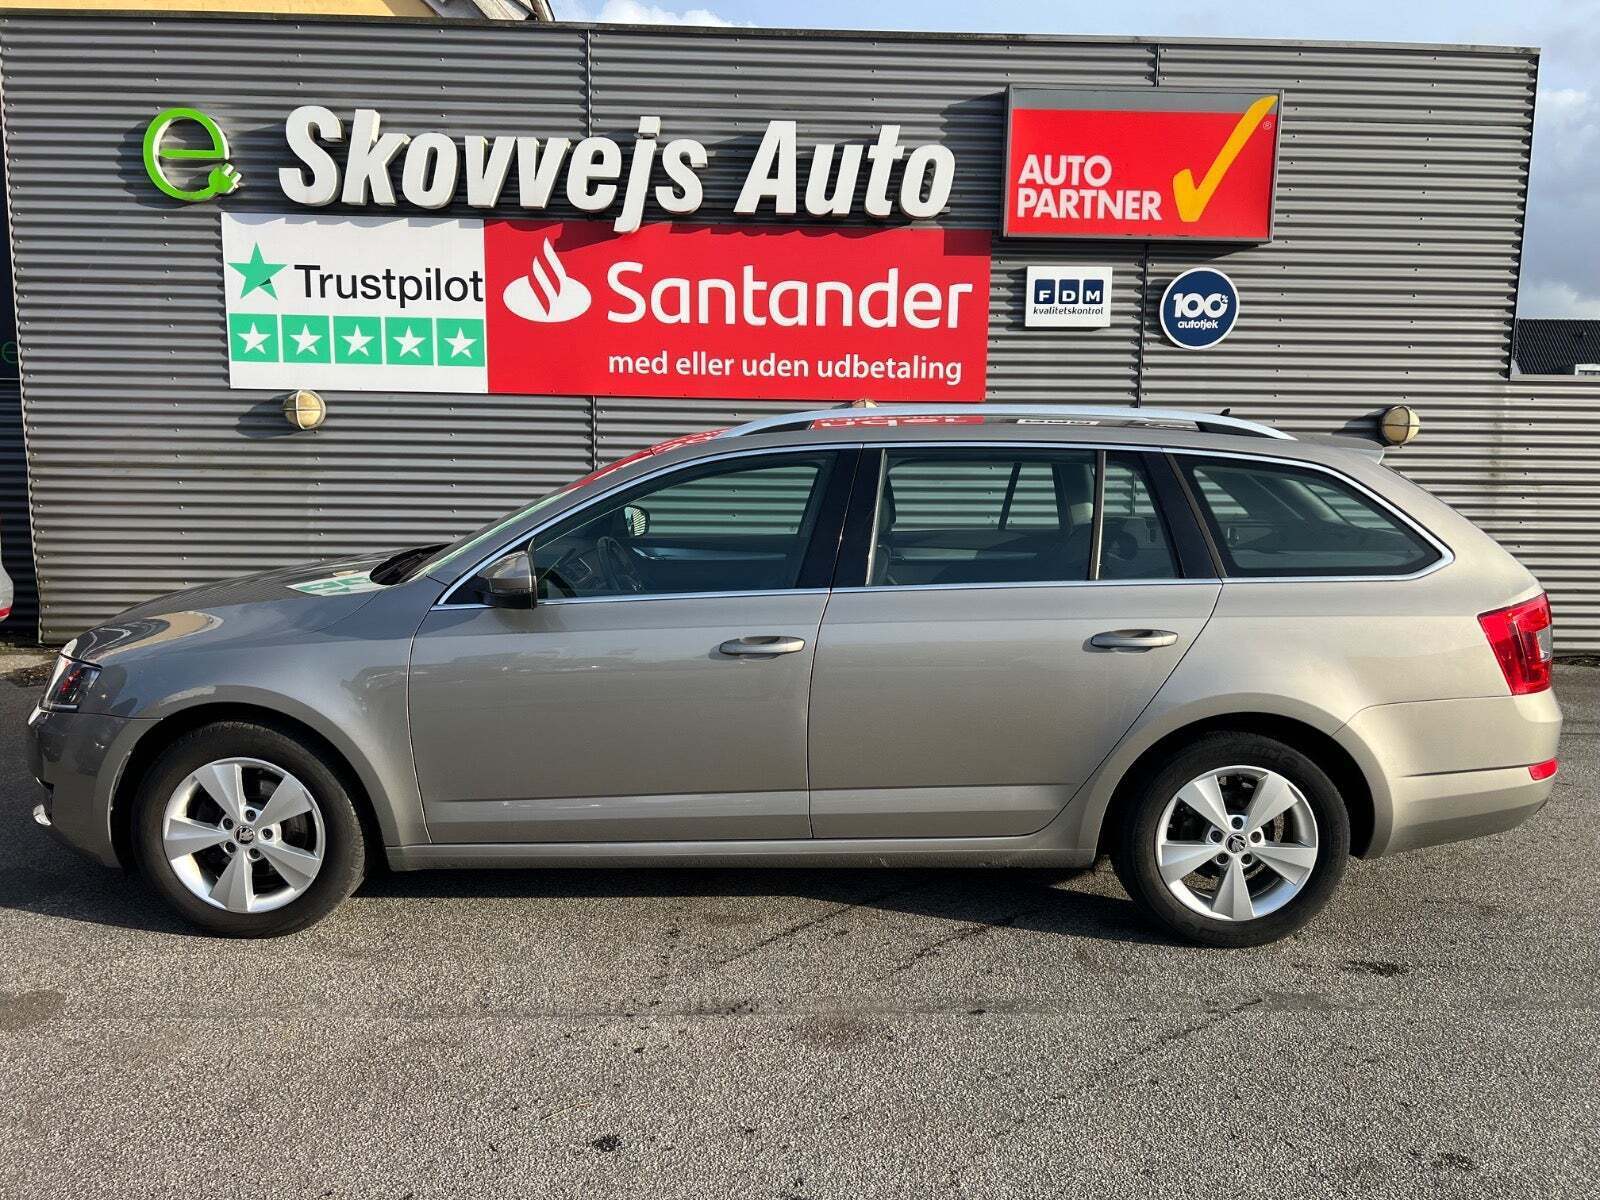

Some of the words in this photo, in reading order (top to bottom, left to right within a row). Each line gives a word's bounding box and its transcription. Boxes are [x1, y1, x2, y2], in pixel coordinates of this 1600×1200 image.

[279, 105, 708, 234] Skovvejs
[733, 120, 956, 219] Auto
[1018, 154, 1112, 187] AUTO
[1016, 188, 1163, 221] PARTNER
[294, 264, 484, 308] Trustpilot
[606, 261, 973, 329] Santander
[1033, 306, 1104, 315] kvalitetskontrol
[1177, 319, 1219, 331] autotjek
[608, 351, 668, 374] med
[675, 353, 734, 376] eller
[741, 354, 809, 378] uden
[817, 354, 962, 386] udbetaling
